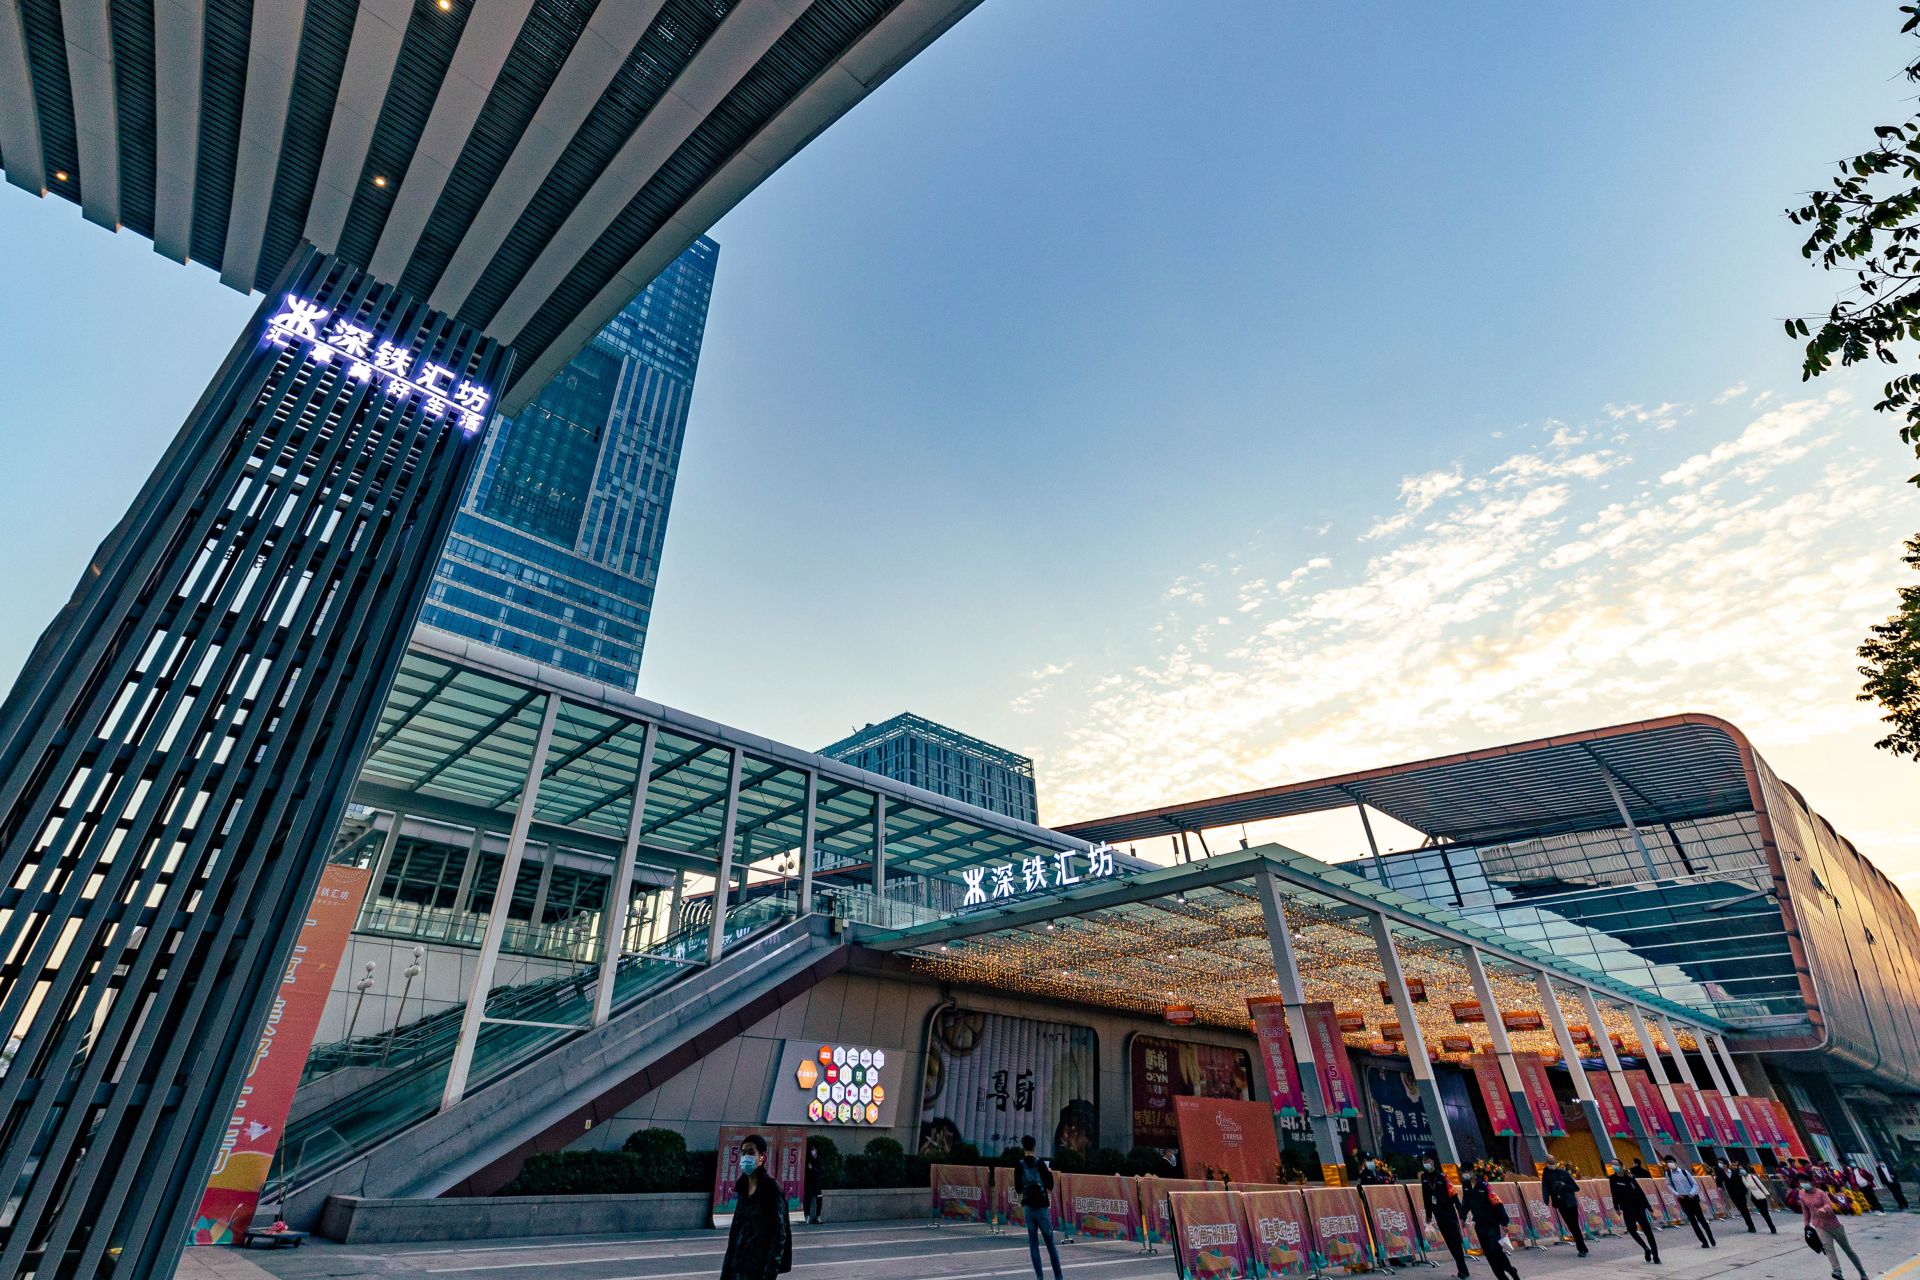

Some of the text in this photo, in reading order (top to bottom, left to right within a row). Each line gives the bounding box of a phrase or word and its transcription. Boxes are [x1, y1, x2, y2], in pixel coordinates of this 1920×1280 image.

[328, 318, 490, 412] 深铁汇坊
[991, 841, 1114, 898] 深铁汇坊
